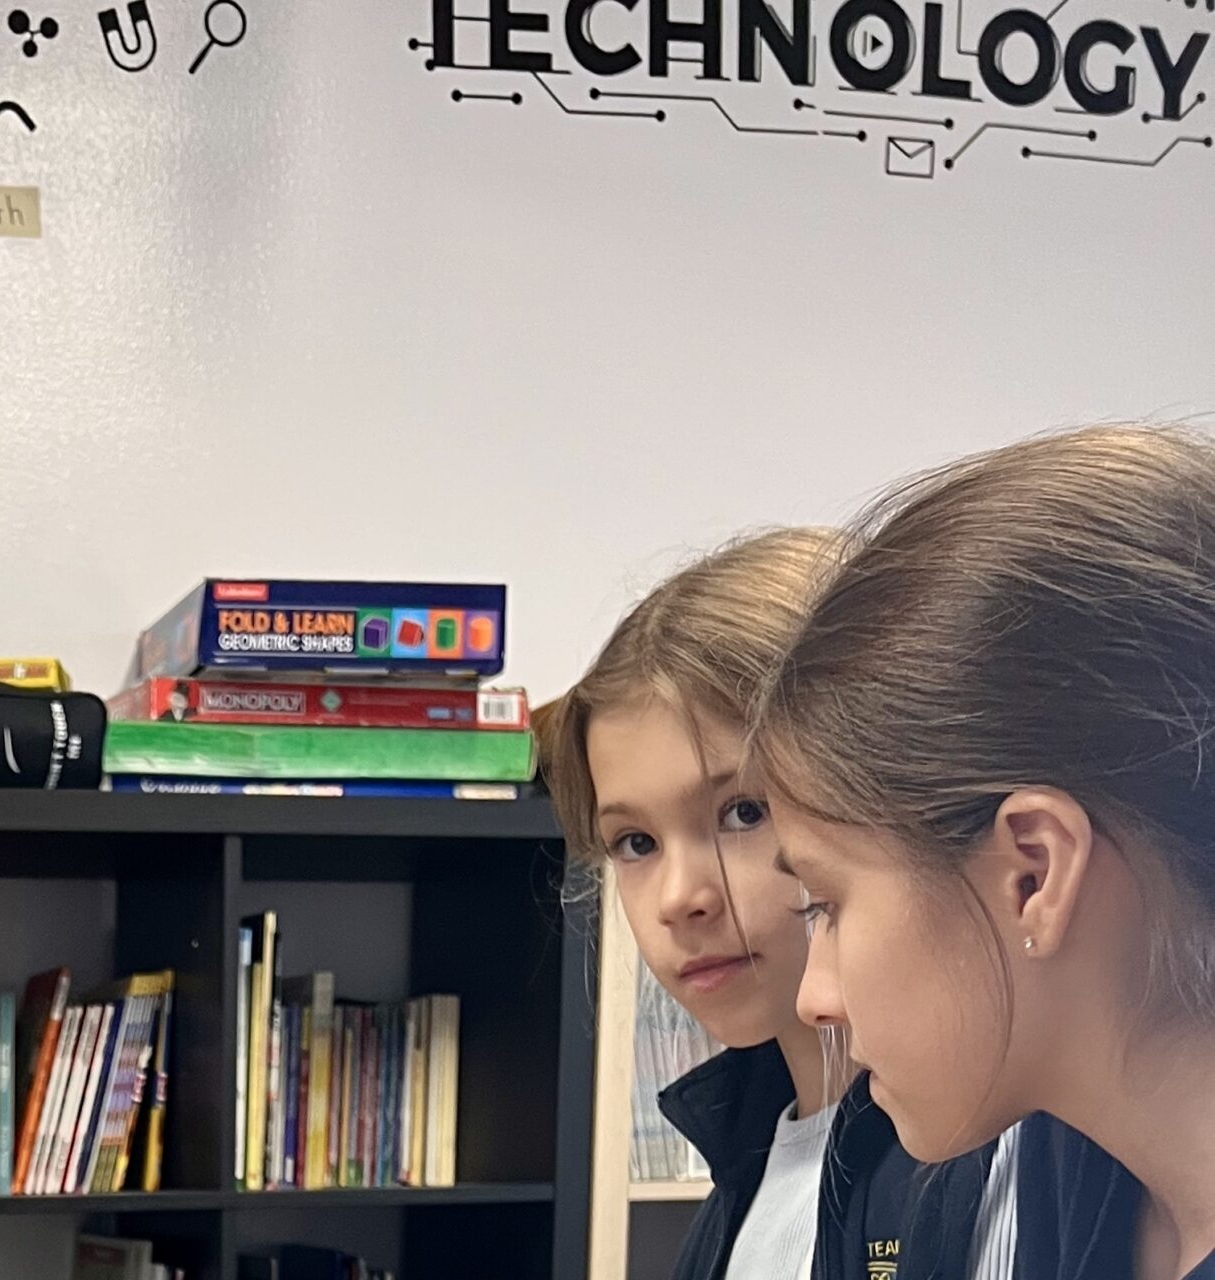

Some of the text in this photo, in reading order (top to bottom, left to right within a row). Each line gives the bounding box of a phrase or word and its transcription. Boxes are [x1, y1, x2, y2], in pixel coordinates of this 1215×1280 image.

[218, 610, 356, 635] FOLD & LEARN
[218, 633, 354, 652] GEOMETRIC SHAPES
[203, 691, 301, 712] MONOPOLY
